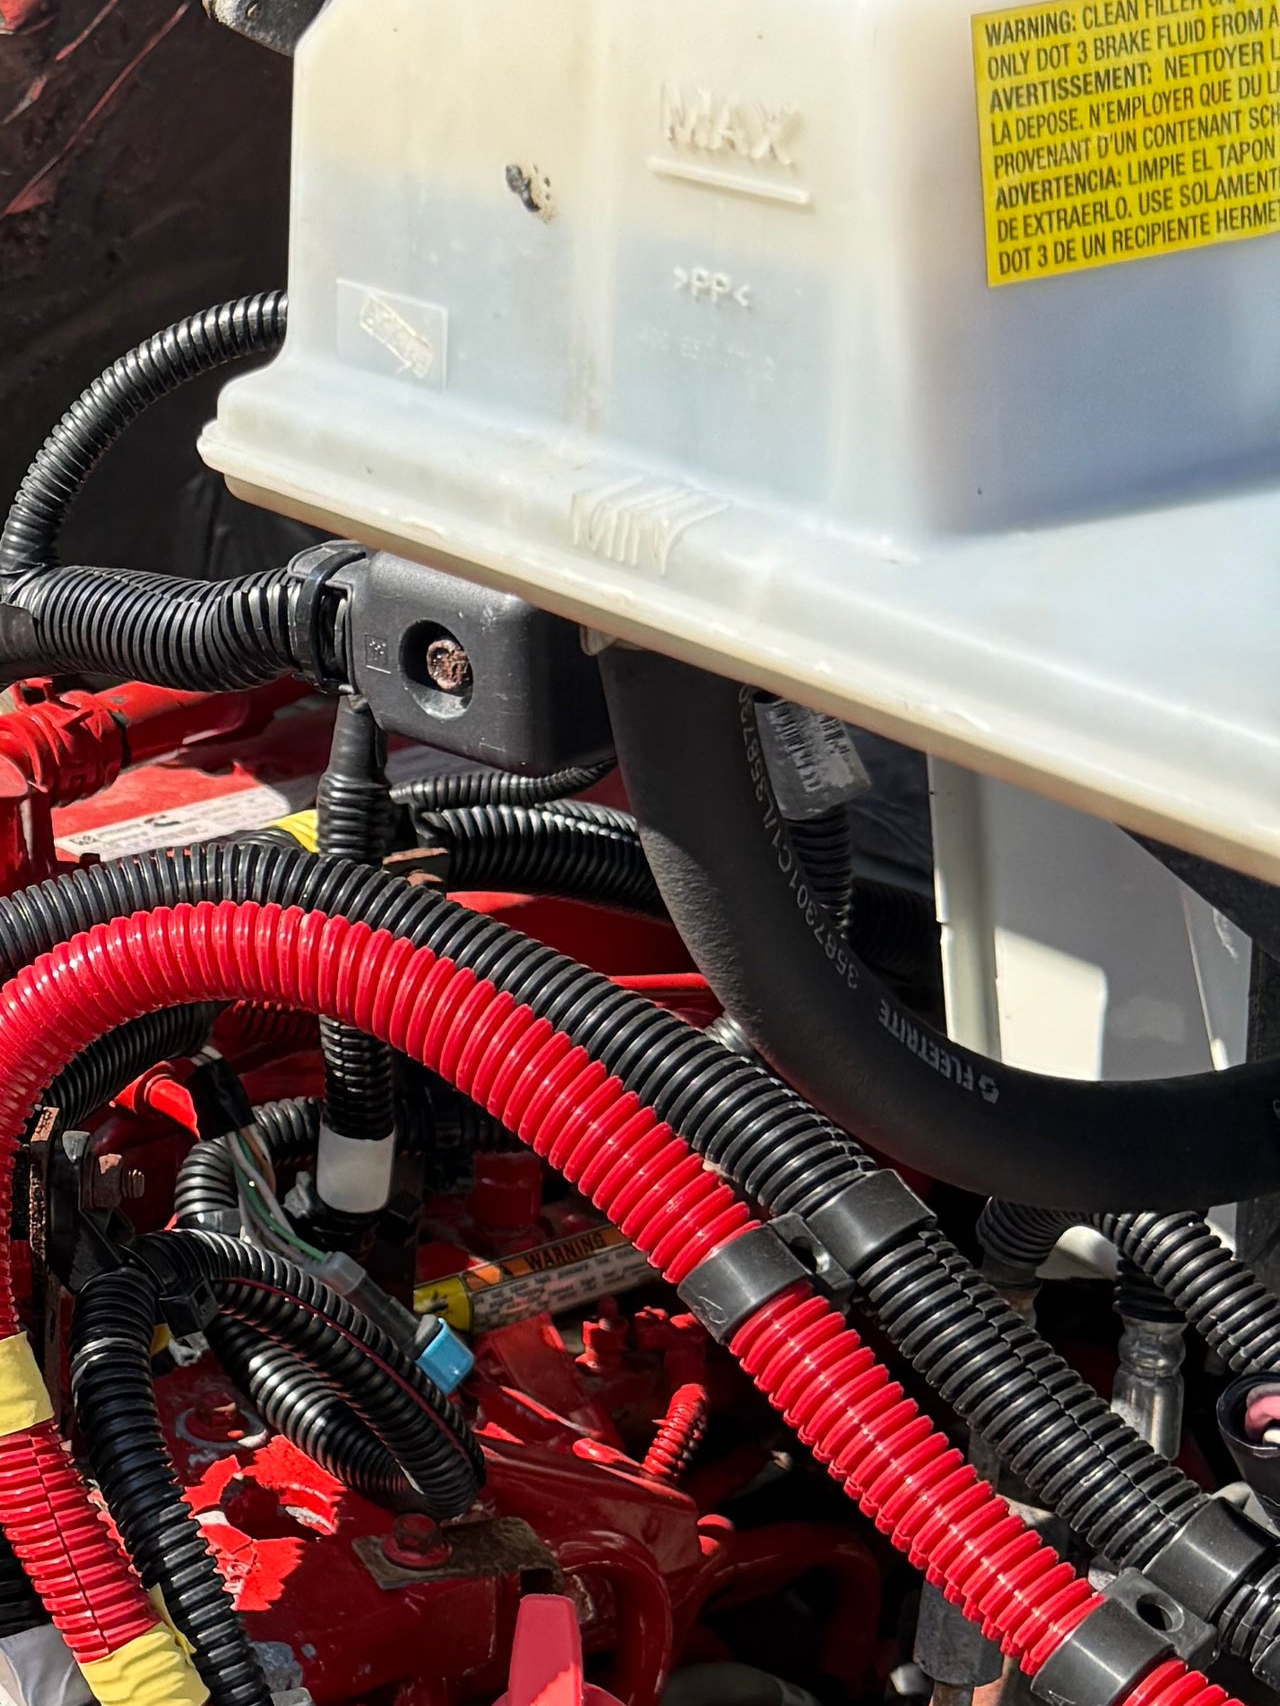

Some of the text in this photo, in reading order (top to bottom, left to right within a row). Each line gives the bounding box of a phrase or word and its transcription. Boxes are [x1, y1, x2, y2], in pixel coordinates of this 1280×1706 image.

[985, 14, 1076, 47] WARNING:
[987, 53, 1029, 80] ONLY
[1037, 45, 1071, 71] DOT
[1077, 41, 1088, 64] 3
[1094, 29, 1151, 61] BRAKE
[1157, 19, 1206, 50] FLUID
[1212, 10, 1264, 39] FROM
[990, 63, 1152, 114] AVERTISSEMENT:
[1164, 45, 1264, 81] NETTOYER
[991, 120, 1011, 145] LA
[1200, 80, 1232, 106] QUE
[1239, 76, 1262, 98] DU
[994, 139, 1091, 178] PROVENANT
[1143, 110, 1242, 150] CONTENANT
[996, 137, 1276, 210] ADVERTENCIA: LIMPIE EL TAPON
[998, 216, 1019, 242] DE
[1139, 190, 1173, 215] USE
[999, 248, 1031, 275] DOT
[1038, 245, 1048, 268] 3
[1054, 239, 1076, 264] DE
[1082, 233, 1106, 259] UN
[1112, 212, 1211, 253] RECIPIENTE
[878, 999, 977, 1095] FLEETRITE
[524, 1234, 605, 1271] WARNING
